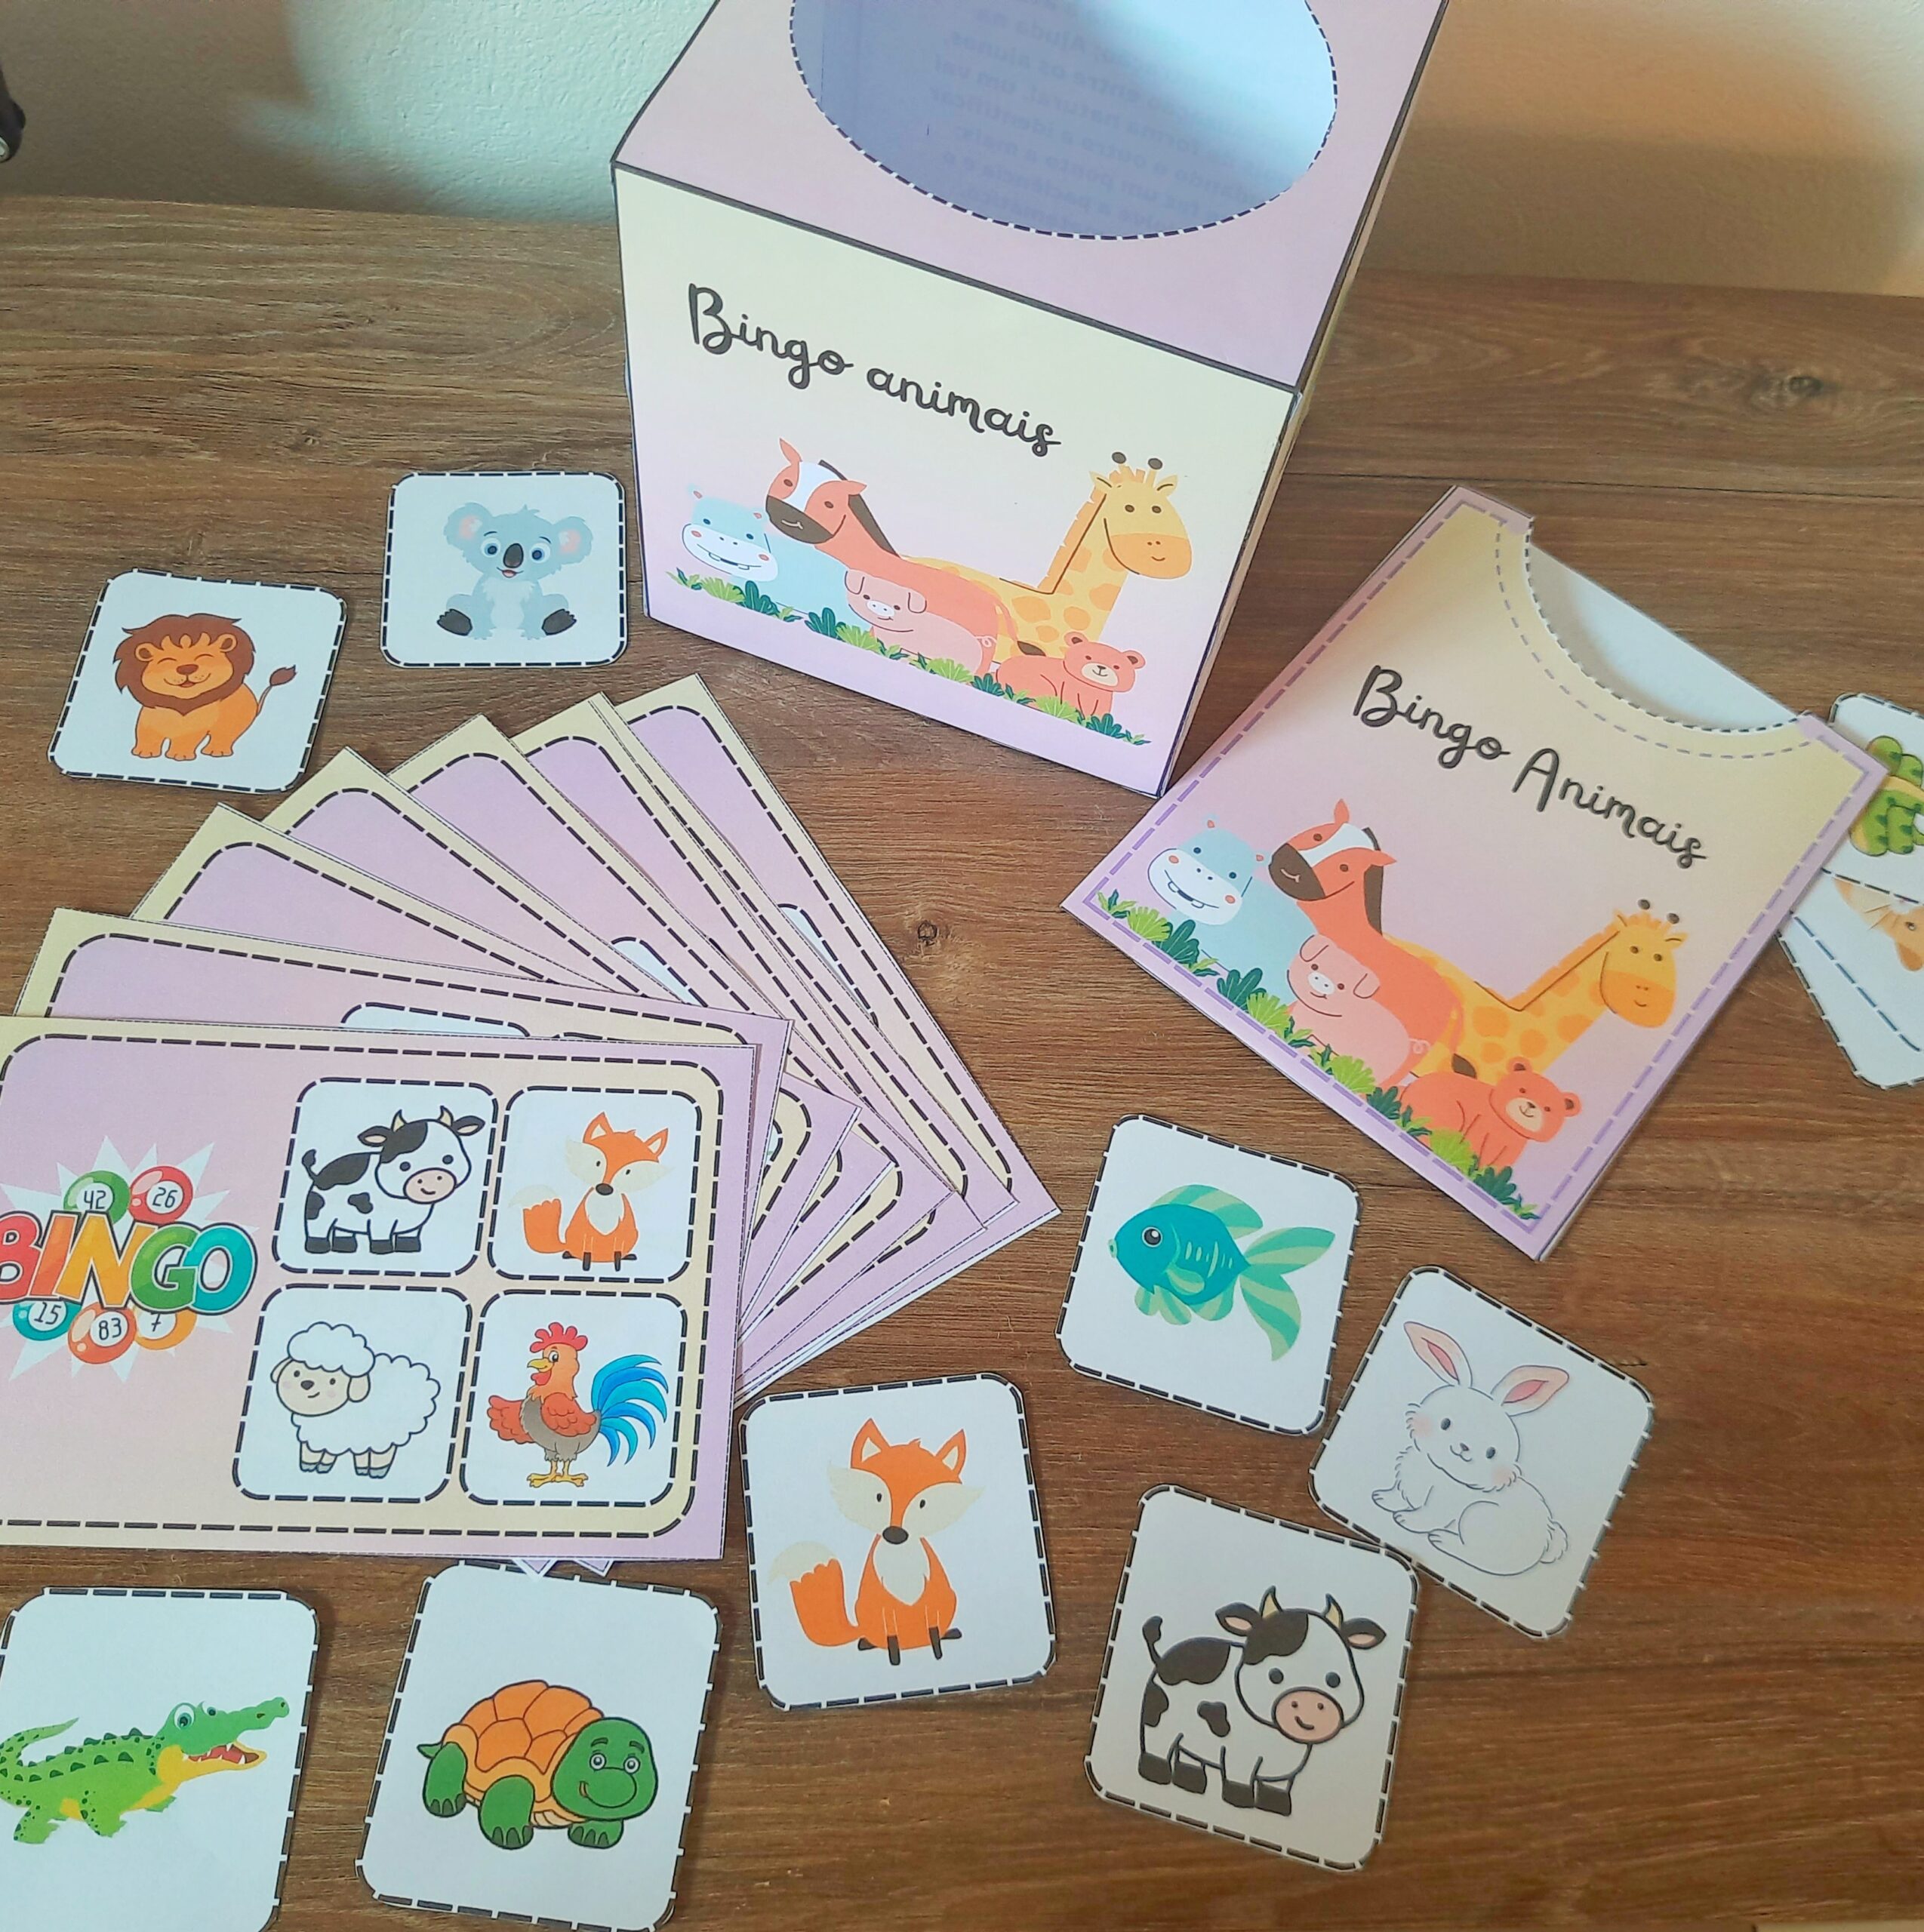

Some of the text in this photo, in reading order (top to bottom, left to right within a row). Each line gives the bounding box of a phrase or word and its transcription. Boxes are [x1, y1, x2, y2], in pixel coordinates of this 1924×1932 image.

[689, 283, 1061, 457] Bingo animais
[1353, 665, 1707, 869] Bingo Animais
[84, 1190, 106, 1210] 42
[152, 1187, 178, 1208] 26
[0, 1210, 257, 1316] BINGO
[34, 1302, 61, 1325] 15
[99, 1318, 122, 1340] 83
